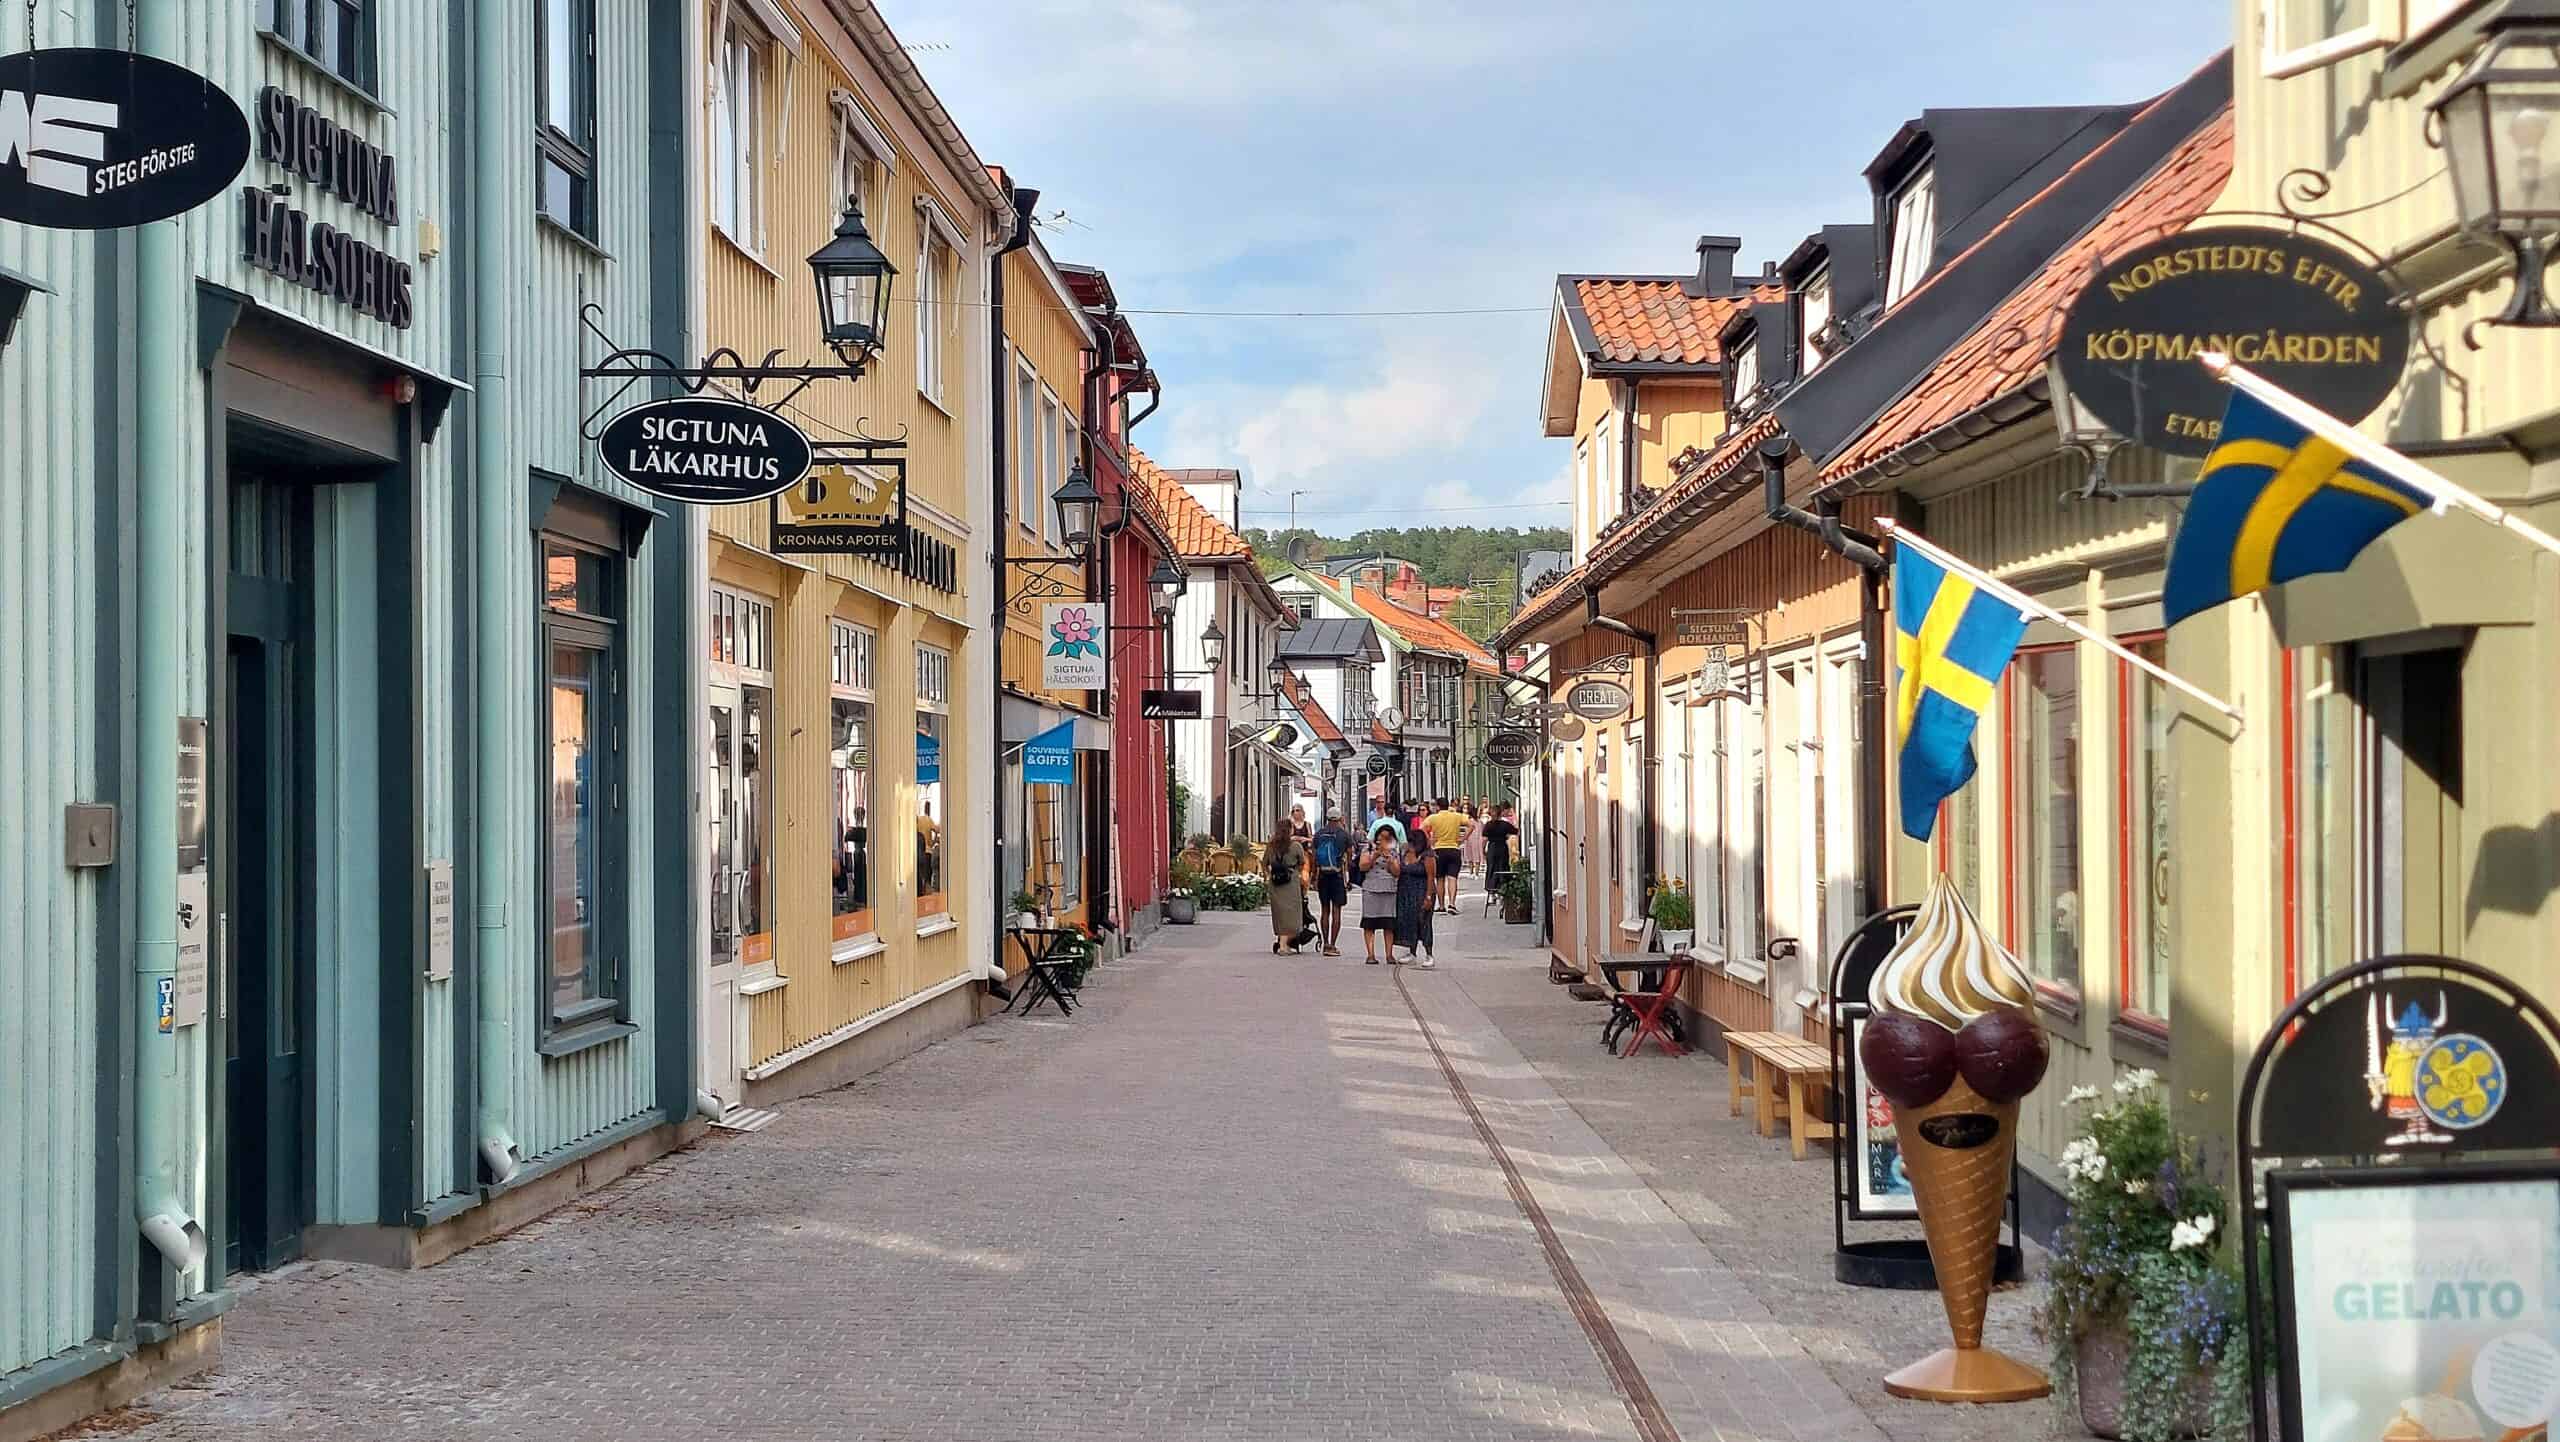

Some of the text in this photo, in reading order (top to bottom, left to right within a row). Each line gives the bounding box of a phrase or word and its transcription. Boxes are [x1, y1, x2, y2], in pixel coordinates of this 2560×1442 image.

[256, 85, 400, 227] SIGTUNA
[95, 143, 196, 194] STEG FÖR STEG
[243, 184, 412, 330] HÄLSOHUS
[2107, 245, 2287, 303] NORSTEDTS
[2086, 327, 2382, 363] KÖPMANGÅRDEN
[641, 416, 769, 448] SIGTUNA
[628, 445, 780, 482] LÄKARHUS
[778, 533, 898, 547] KRONANS APOTEK
[1679, 634, 1745, 644] BOKHANDEL
[1689, 624, 1738, 634] SIGTUNA
[1045, 674, 1104, 684] HÄLSOKOST
[1053, 665, 1095, 674] SIGTUNA
[1578, 689, 1619, 705] CREATE
[1027, 746, 1070, 755] SOUVENIRS
[1489, 744, 1533, 754] BIOGRAF
[2332, 1279, 2525, 1322] GELATO
